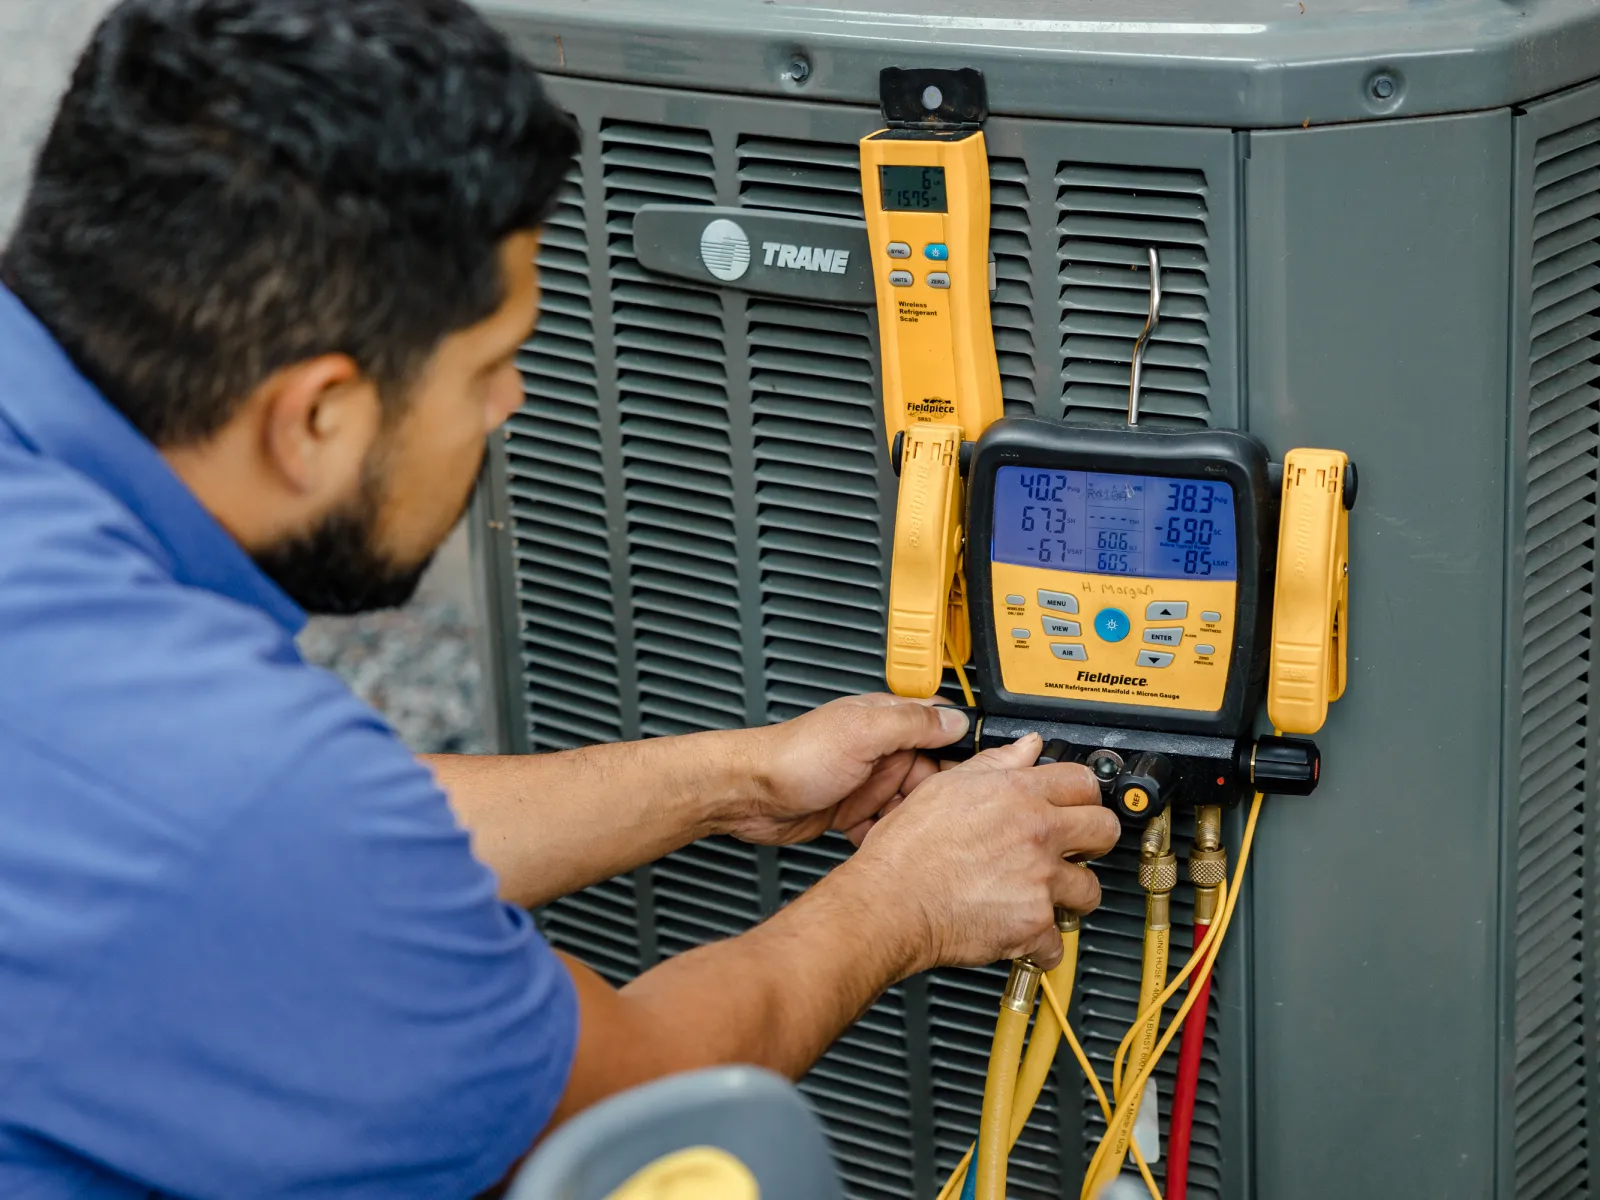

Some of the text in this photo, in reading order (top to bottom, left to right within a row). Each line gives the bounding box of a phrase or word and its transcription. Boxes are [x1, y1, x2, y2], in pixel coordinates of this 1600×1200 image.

[922, 170, 931, 190] 6
[762, 241, 850, 275] TRANE
[898, 301, 928, 309] Wireless
[899, 308, 938, 317] Refrigerant
[906, 402, 955, 414] Fieldpiece
[1166, 483, 1214, 514] 38.3
[1022, 505, 1067, 534] 67.3
[1082, 581, 1096, 593] H.
[1046, 599, 1067, 607] MENU
[1151, 633, 1173, 642] ENTER
[1061, 649, 1074, 657] AIR
[1076, 670, 1148, 687] Fieldpiece
[1065, 684, 1101, 693] Refrigerant
[1101, 687, 1130, 696] Manifold
[1136, 690, 1159, 698] Micron
[1159, 692, 1180, 700] Gauge
[1131, 792, 1141, 807] REF
[1154, 956, 1164, 979] HOSE
